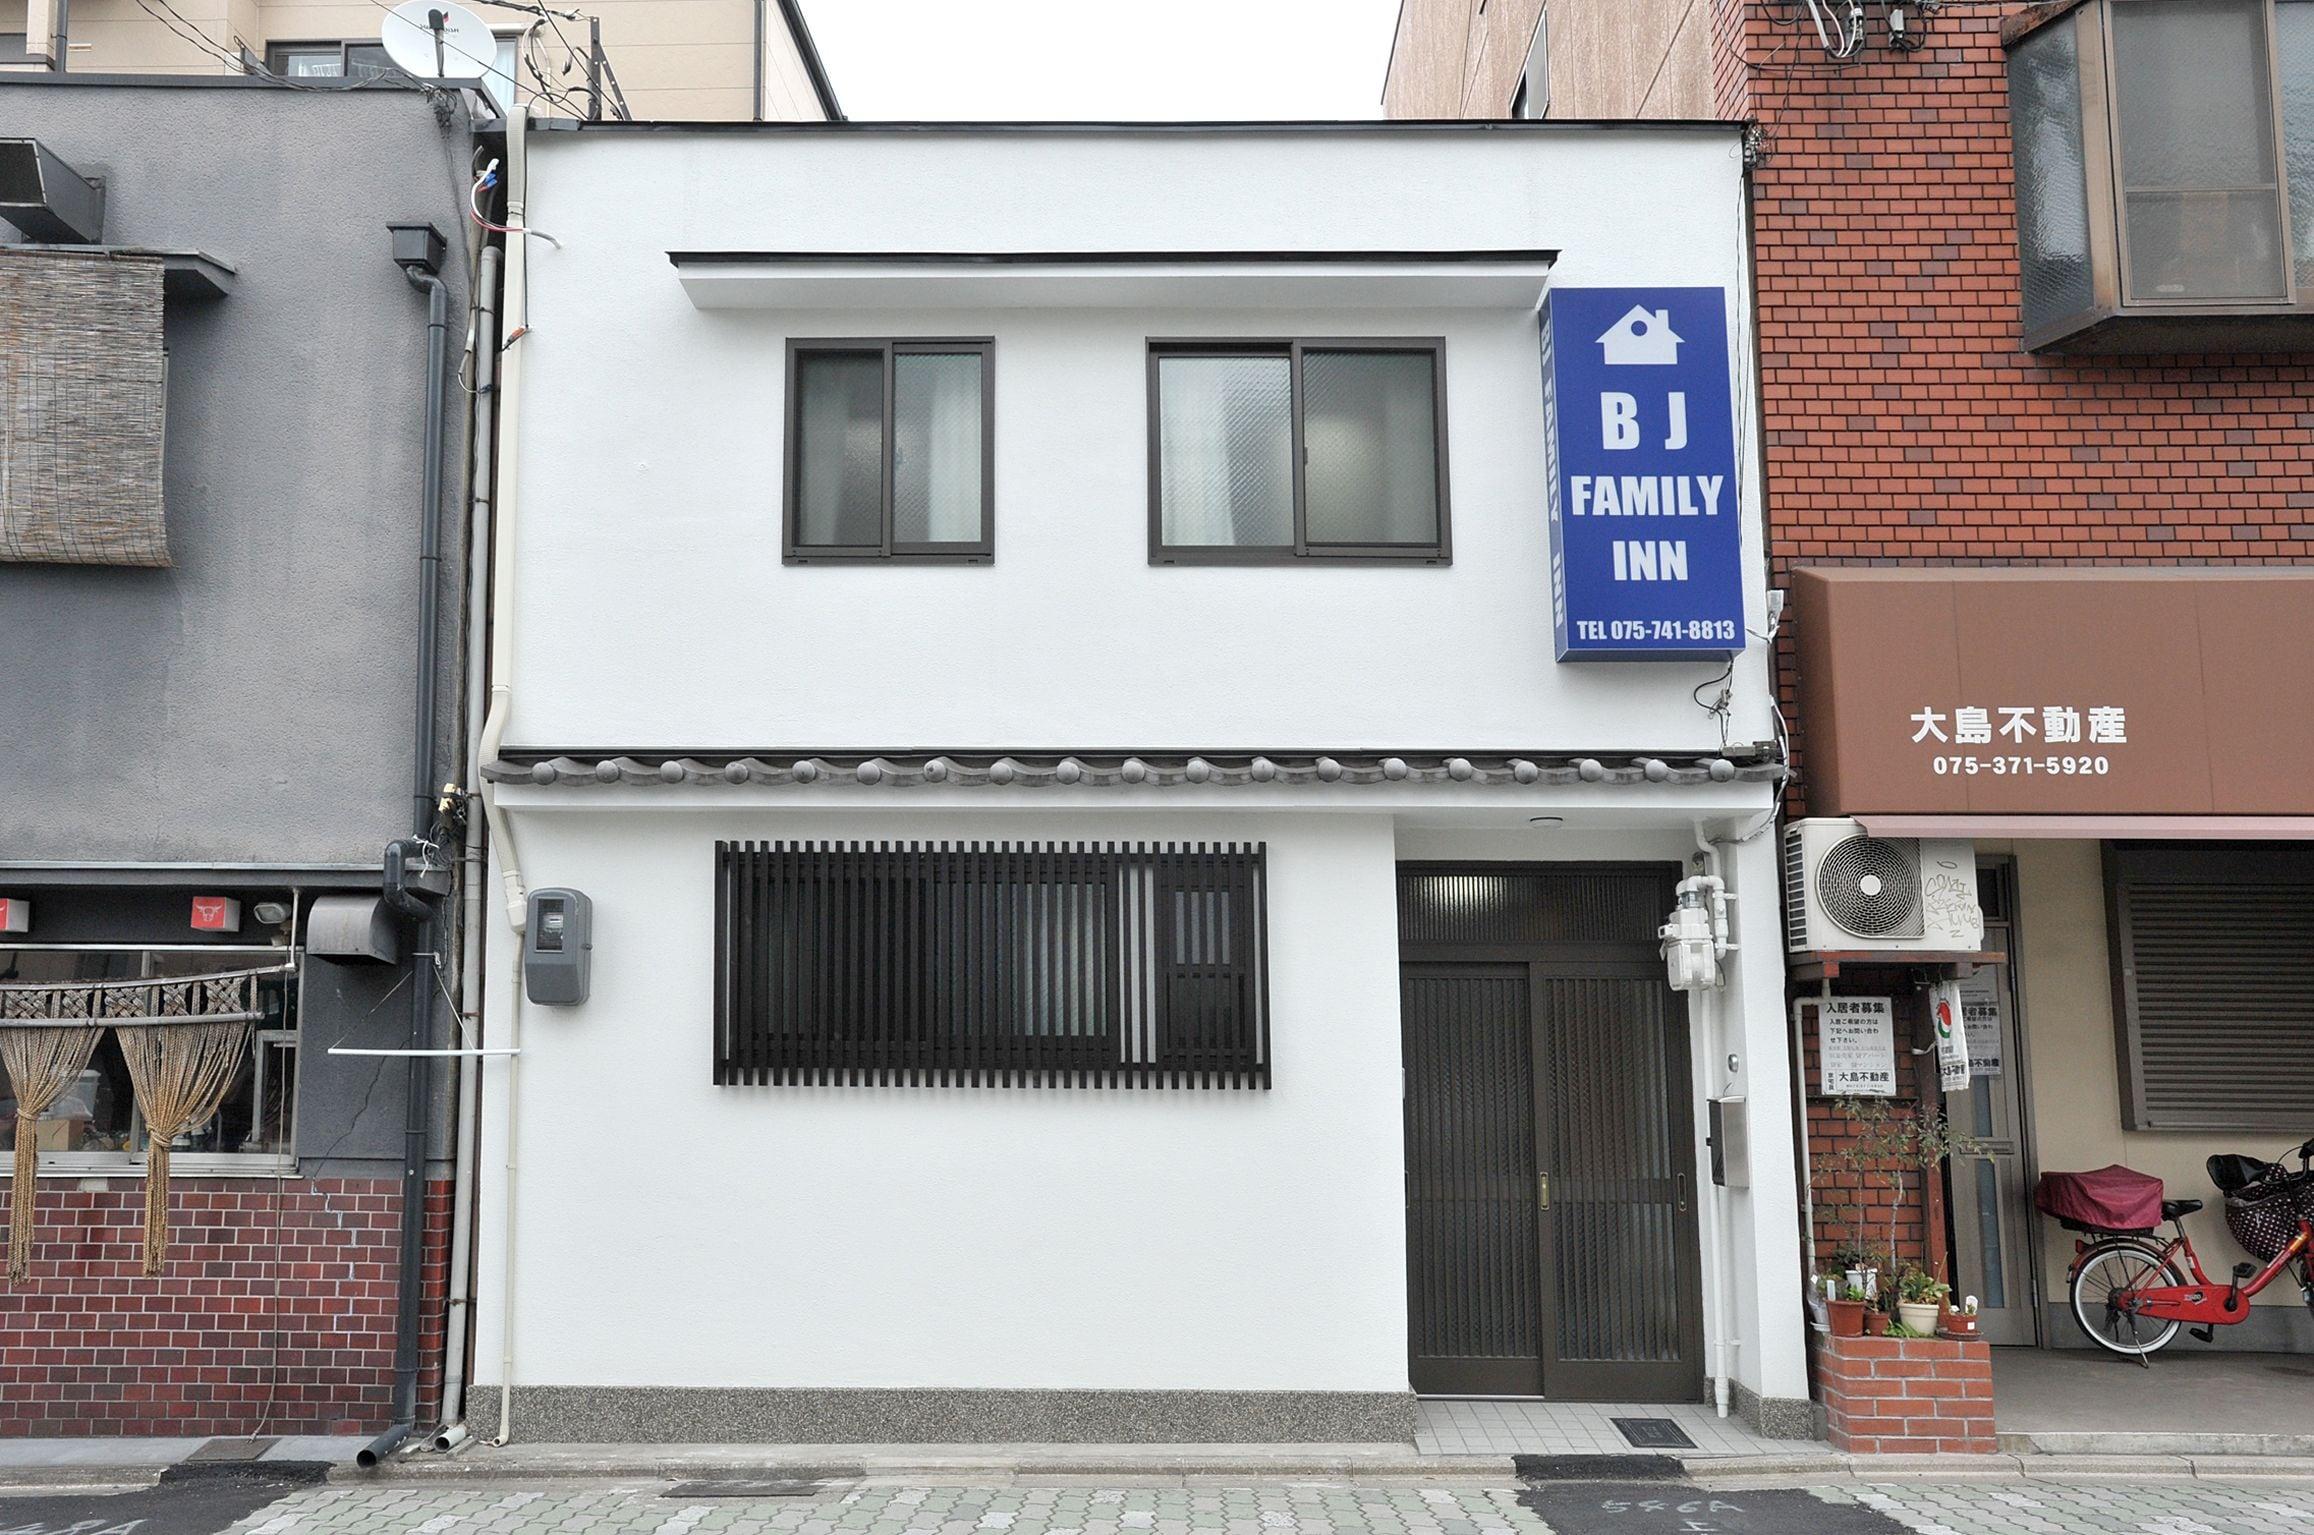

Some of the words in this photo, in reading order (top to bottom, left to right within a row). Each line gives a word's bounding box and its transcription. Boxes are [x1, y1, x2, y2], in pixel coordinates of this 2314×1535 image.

[1600, 391, 1640, 450] B
[1664, 391, 1688, 450] J
[1543, 377, 1560, 524] FAMILY
[1552, 552, 1564, 629] INN
[1570, 475, 1725, 516] FAMILY
[1612, 540, 1688, 581] INN
[1576, 620, 1608, 640] TEL
[1611, 620, 1736, 640] 075-741-8813
[1910, 706, 2128, 744] 大島不動産
[1932, 756, 2109, 775] 075-371-5920
[1826, 1002, 1885, 1014] 入居者募集
[1838, 1071, 1890, 1082] 大島不動産
